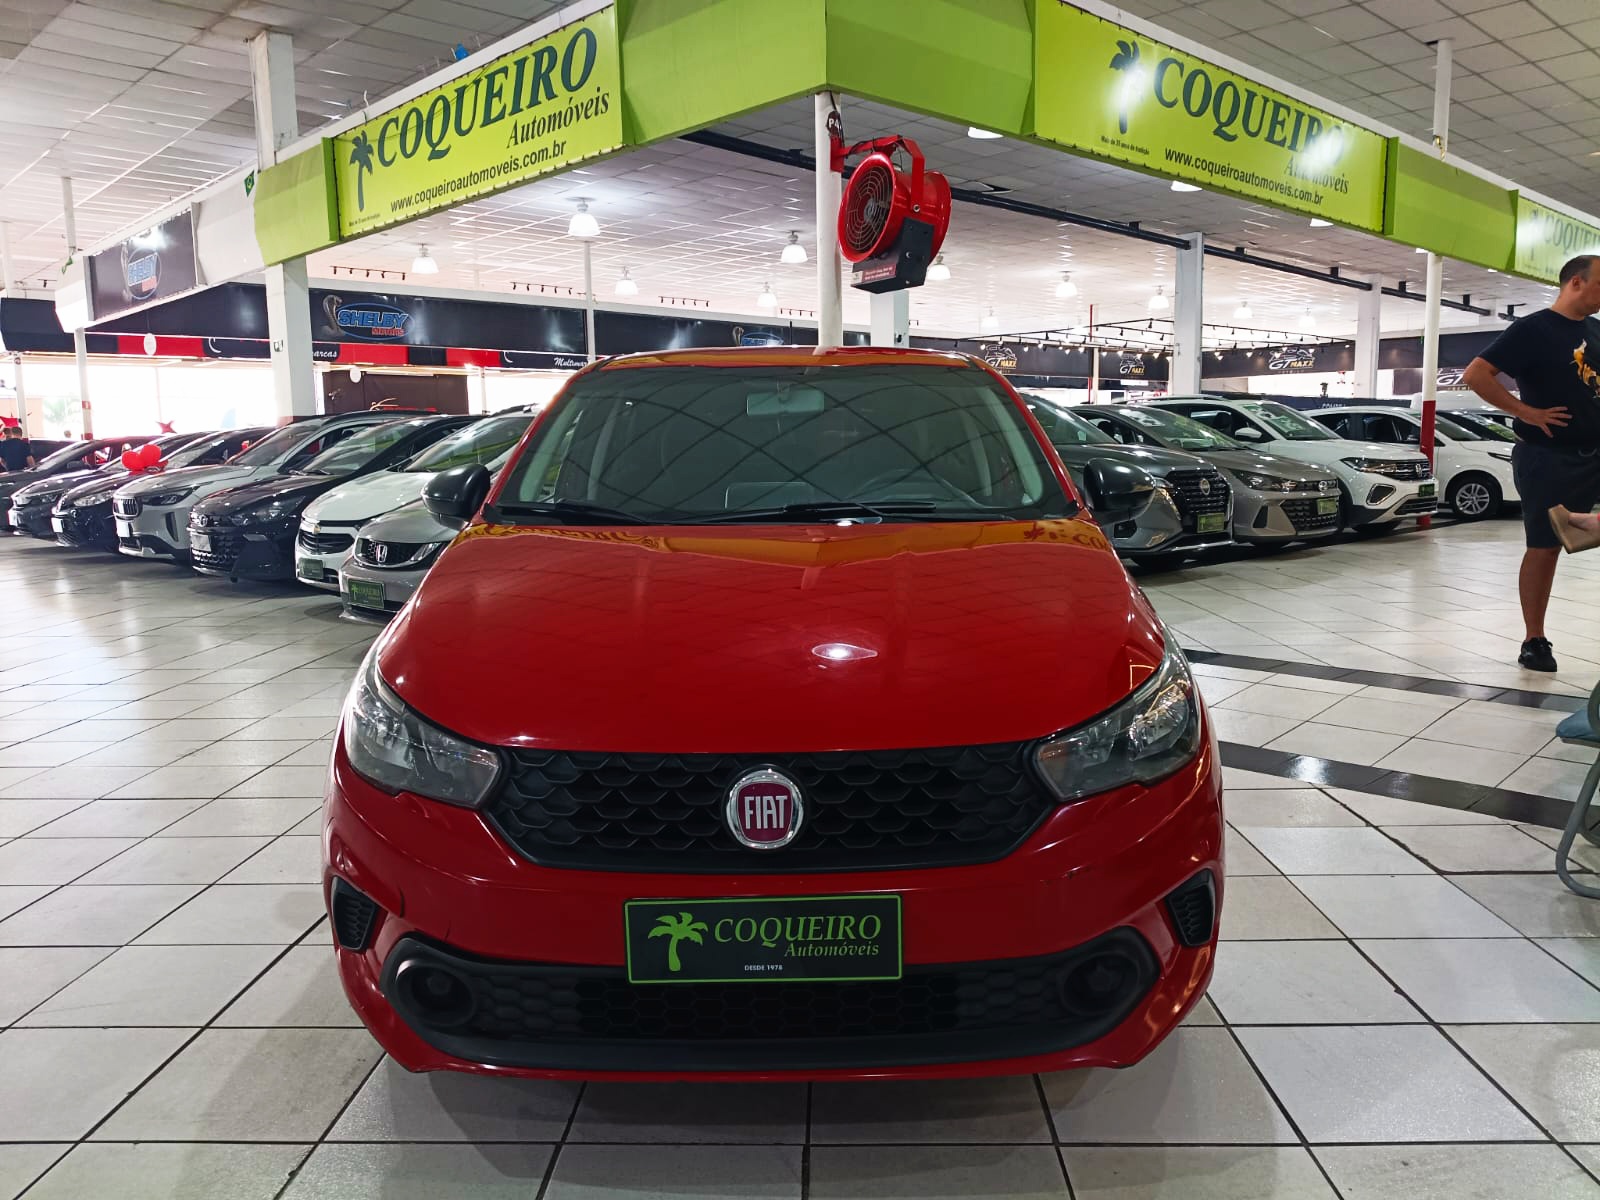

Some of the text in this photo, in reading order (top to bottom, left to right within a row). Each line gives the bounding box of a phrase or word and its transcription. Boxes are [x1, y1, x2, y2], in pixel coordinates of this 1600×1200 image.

[377, 27, 597, 168] COQUEIRO
[1153, 57, 1345, 167] COQUEIRO
[506, 86, 610, 149] Automóveis
[390, 139, 567, 213] www.coqueiroautomoveis.com.br
[1164, 148, 1324, 206] www.coqueiroautomoveis.com.br
[338, 309, 408, 330] SHELBY
[1120, 364, 1136, 374] GT
[1269, 358, 1314, 370] GT MAXX
[743, 795, 788, 830] FIAT
[714, 914, 882, 948] COQUEIRO
[784, 941, 880, 958] Automóveis
